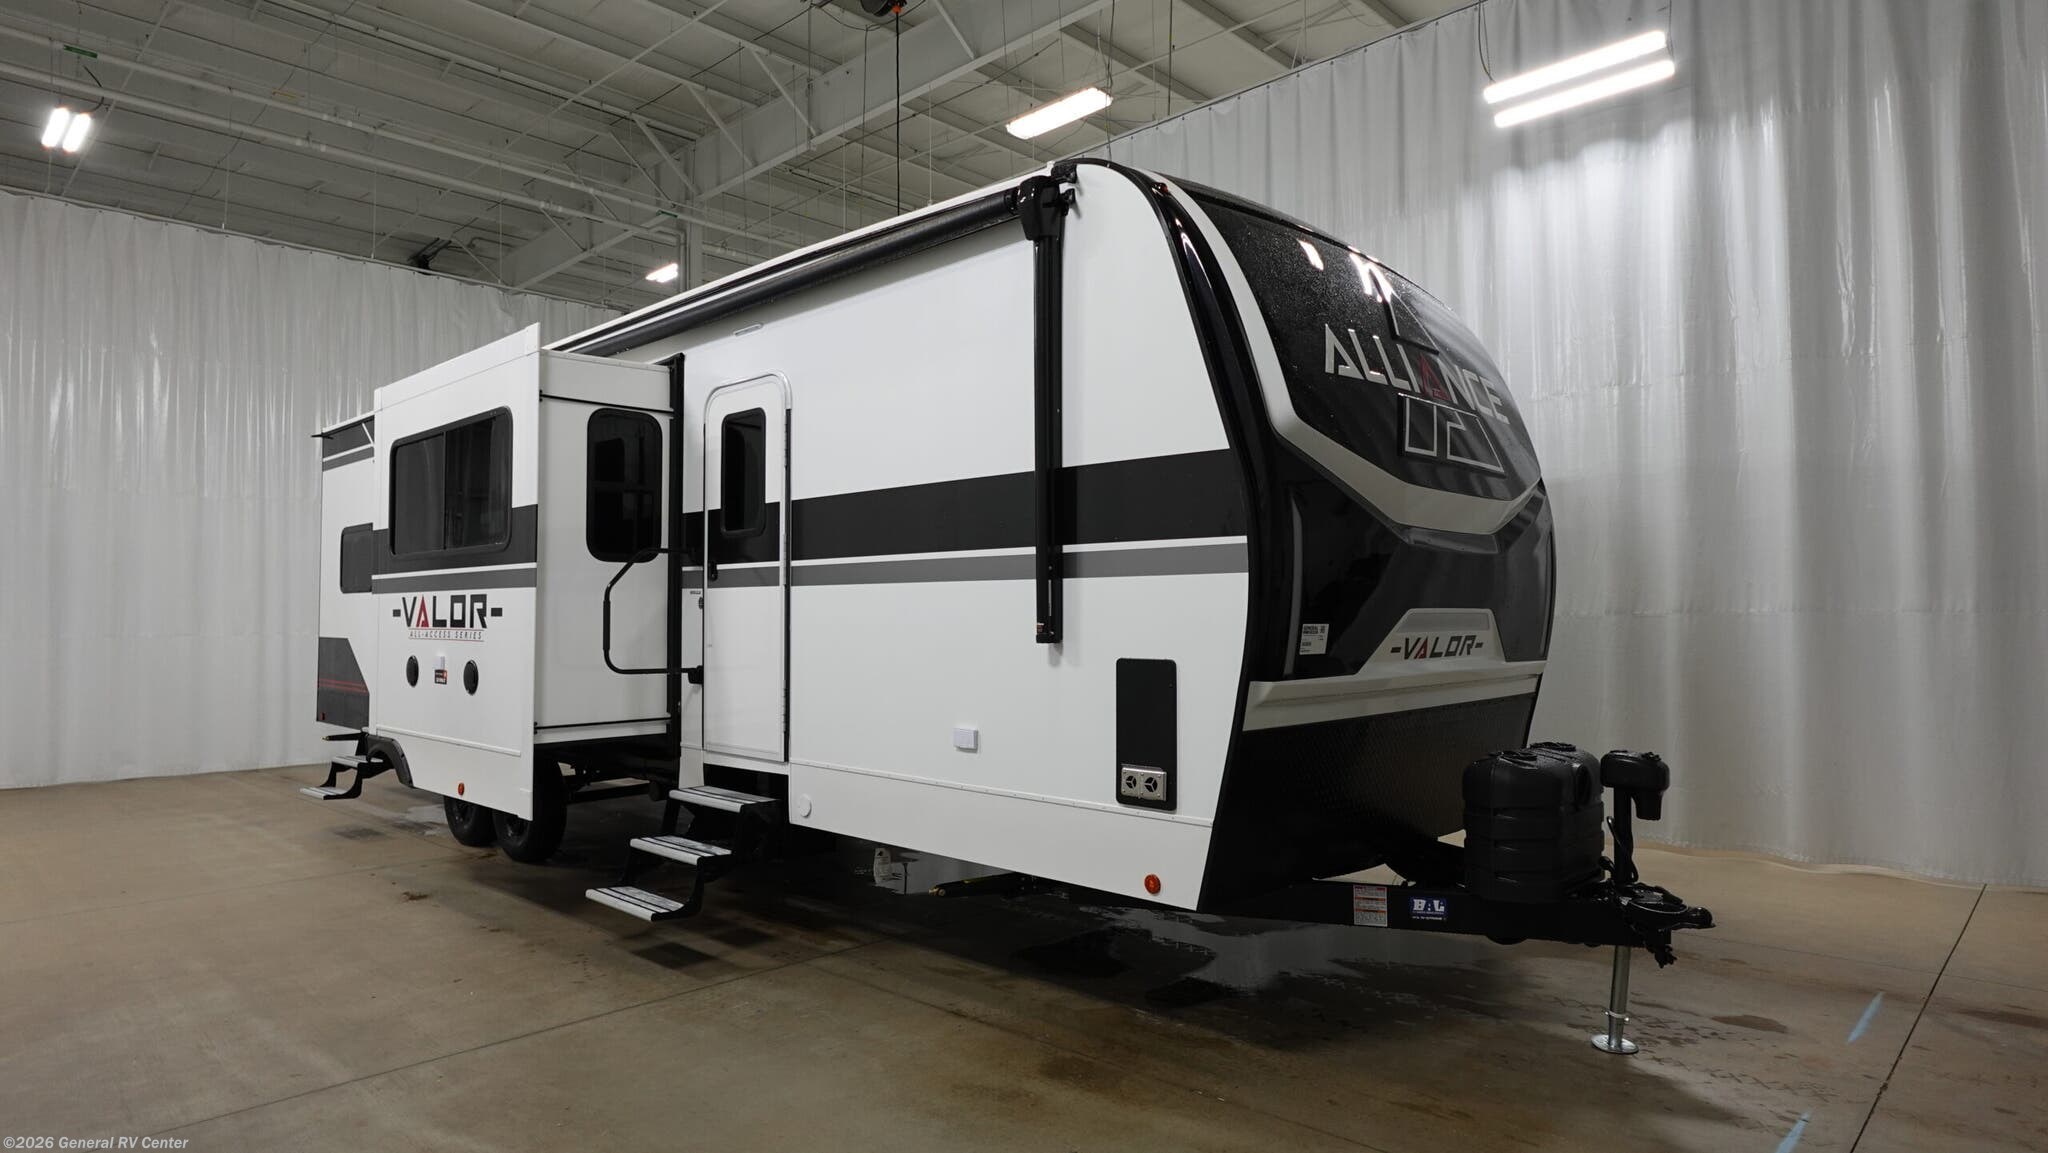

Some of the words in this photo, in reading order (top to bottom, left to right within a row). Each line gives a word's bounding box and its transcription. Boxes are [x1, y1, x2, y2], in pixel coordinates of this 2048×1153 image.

[1325, 323, 1510, 424] ALLIANCE
[409, 630, 451, 639] ALL-ACCESS
[455, 631, 482, 640] SERIES
